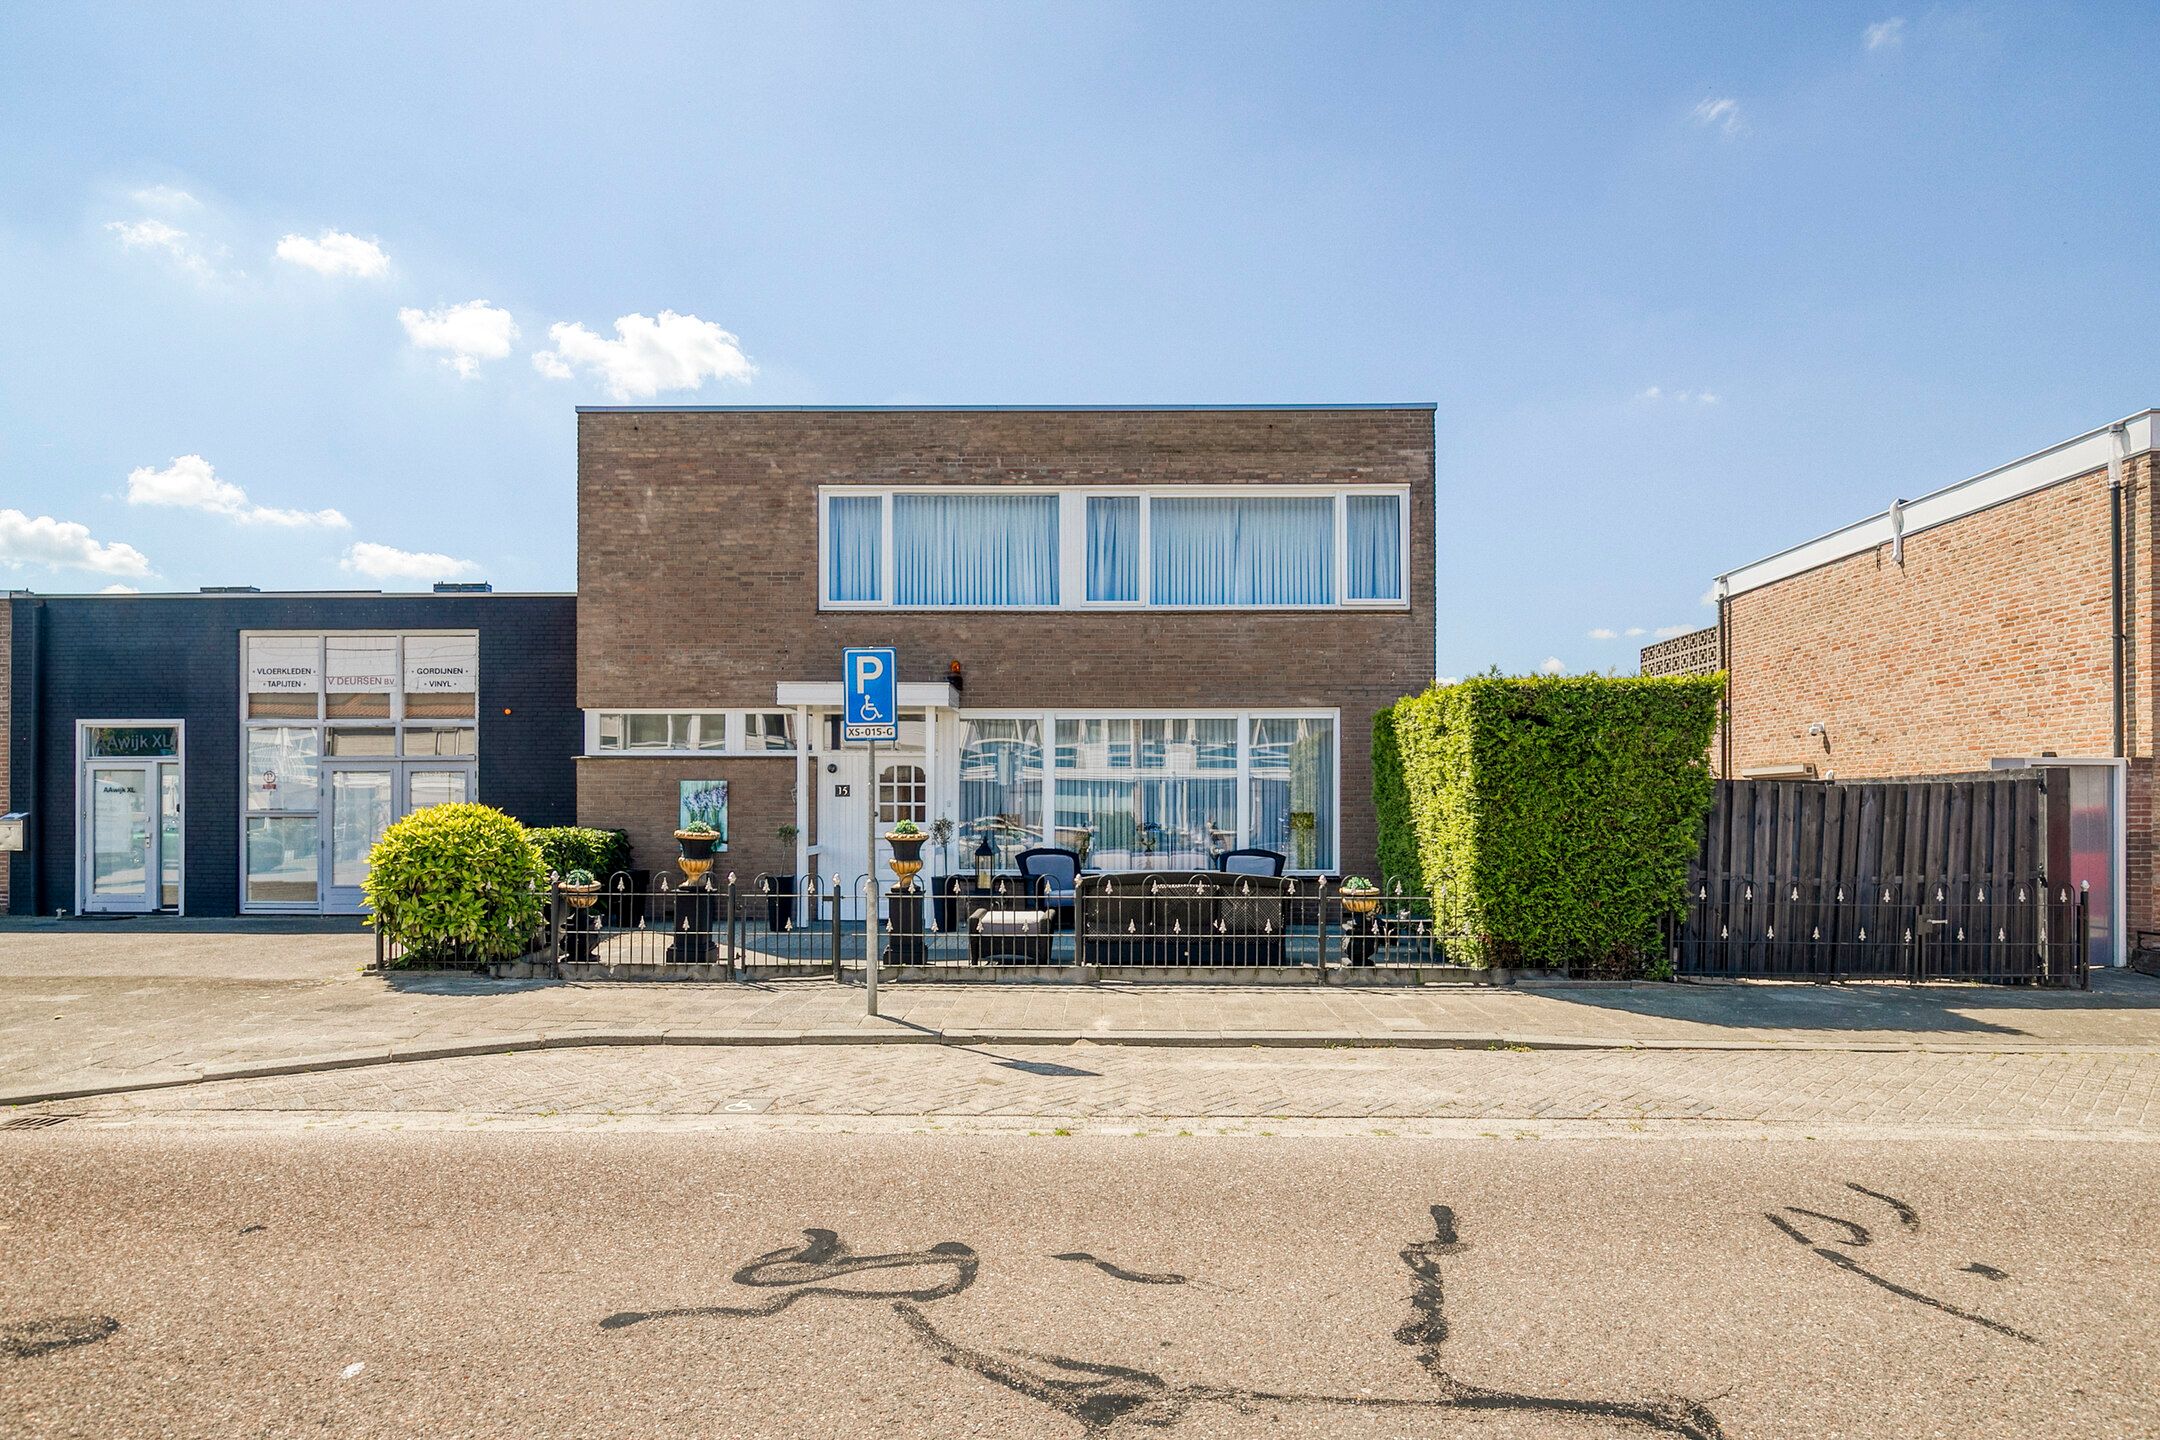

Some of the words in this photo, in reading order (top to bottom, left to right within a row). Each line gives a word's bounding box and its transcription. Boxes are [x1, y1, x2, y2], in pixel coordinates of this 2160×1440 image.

[256, 667, 312, 675] VLOERKLEDEN
[416, 667, 463, 675] GORDIJNEN
[857, 656, 884, 694] P
[267, 680, 302, 688] TAPIJTEN
[337, 676, 382, 686] DEURSEN
[429, 680, 452, 688] VINYL
[848, 727, 893, 737] XS-015-G
[152, 734, 171, 748] XL
[838, 786, 848, 796] 15
